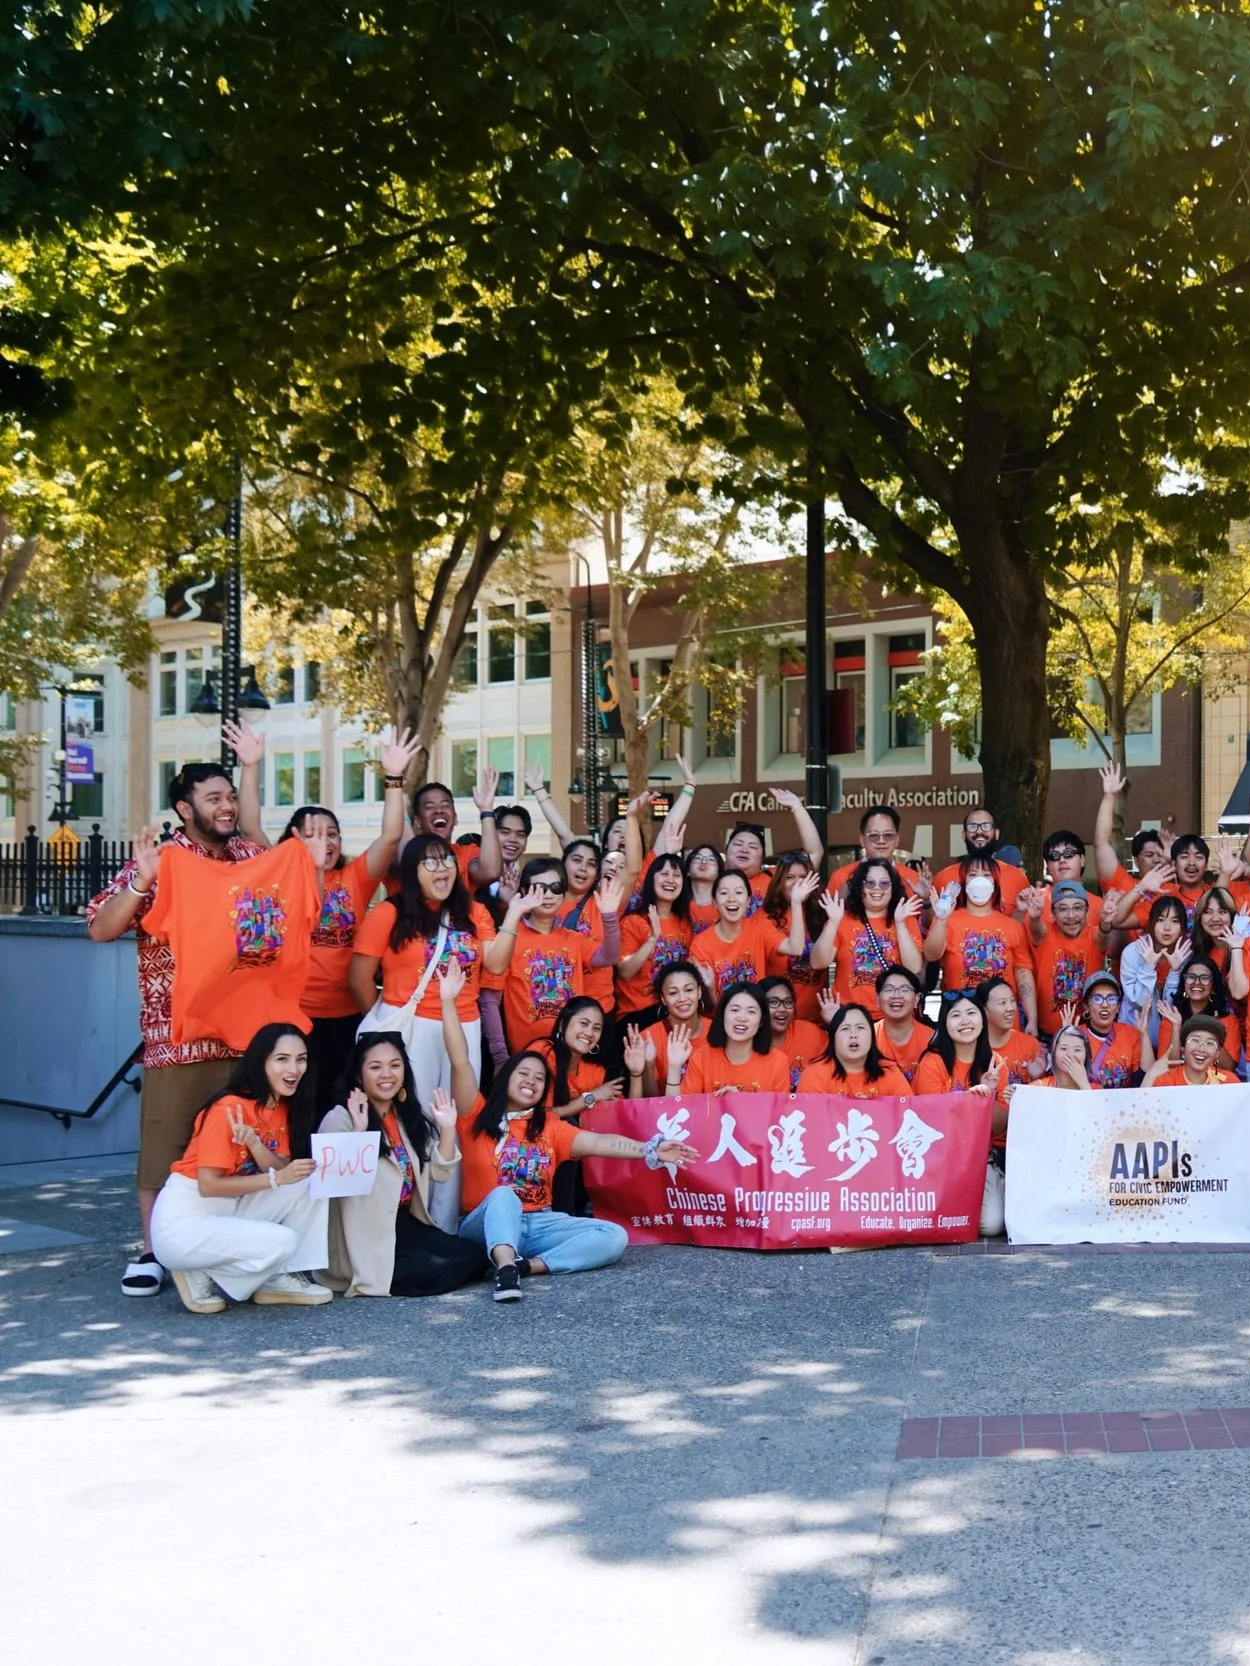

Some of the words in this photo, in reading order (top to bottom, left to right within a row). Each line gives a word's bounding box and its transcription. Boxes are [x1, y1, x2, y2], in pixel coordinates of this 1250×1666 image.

[729, 790, 755, 812] CFA
[888, 787, 979, 808] Association
[321, 1144, 375, 1182] PWC
[1110, 1140, 1193, 1179] AAPIs
[1110, 1182, 1126, 1193] FOR
[1130, 1182, 1152, 1194] CIVIC
[1156, 1179, 1229, 1193] EMPOWERMENT
[666, 1187, 727, 1213] Chinese
[735, 1187, 830, 1216] Progressive
[840, 1187, 936, 1212] Association
[1109, 1198, 1160, 1206] EDUCATION
[1162, 1197, 1188, 1205] FUND
[791, 1216, 831, 1231] cpasf.org
[861, 1216, 895, 1229] Educate.
[899, 1216, 934, 1231] Organize.
[938, 1214, 970, 1230] Empower.
